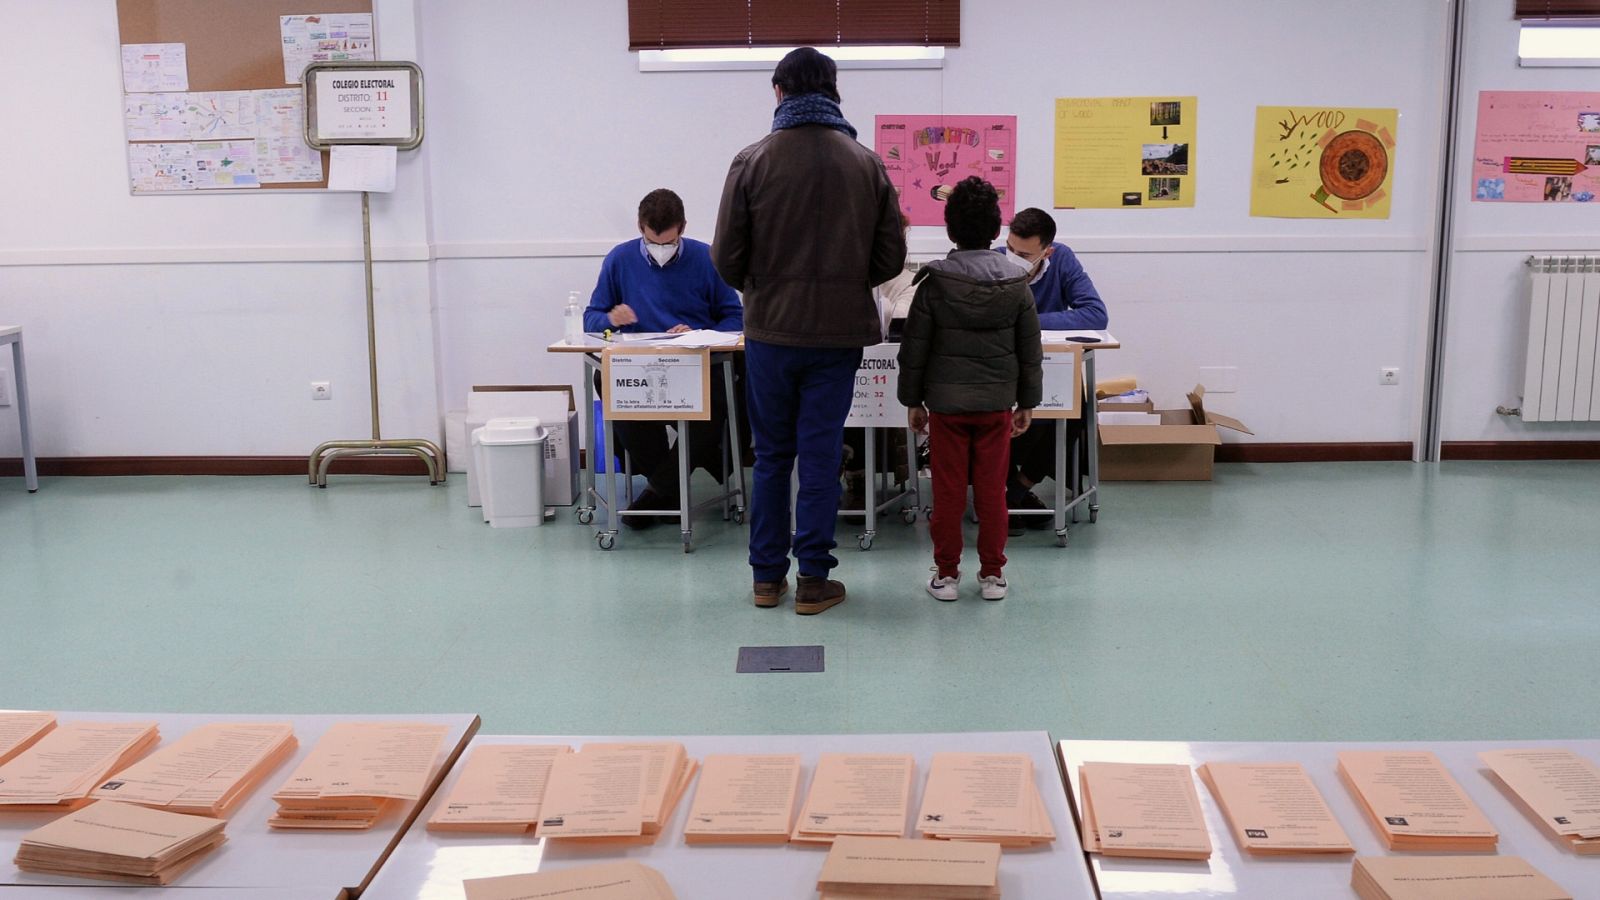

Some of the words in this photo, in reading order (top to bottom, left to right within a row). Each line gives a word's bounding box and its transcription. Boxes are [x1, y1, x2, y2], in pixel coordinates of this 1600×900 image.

[332, 79, 359, 89] COLEGIO
[360, 79, 395, 88] ELECTORAL
[376, 91, 388, 101] 11
[1288, 109, 1345, 129] WOOD
[925, 151, 957, 171] Wood
[858, 358, 896, 370] LECTORAL
[616, 378, 648, 388] MESA
[872, 374, 888, 385] 11
